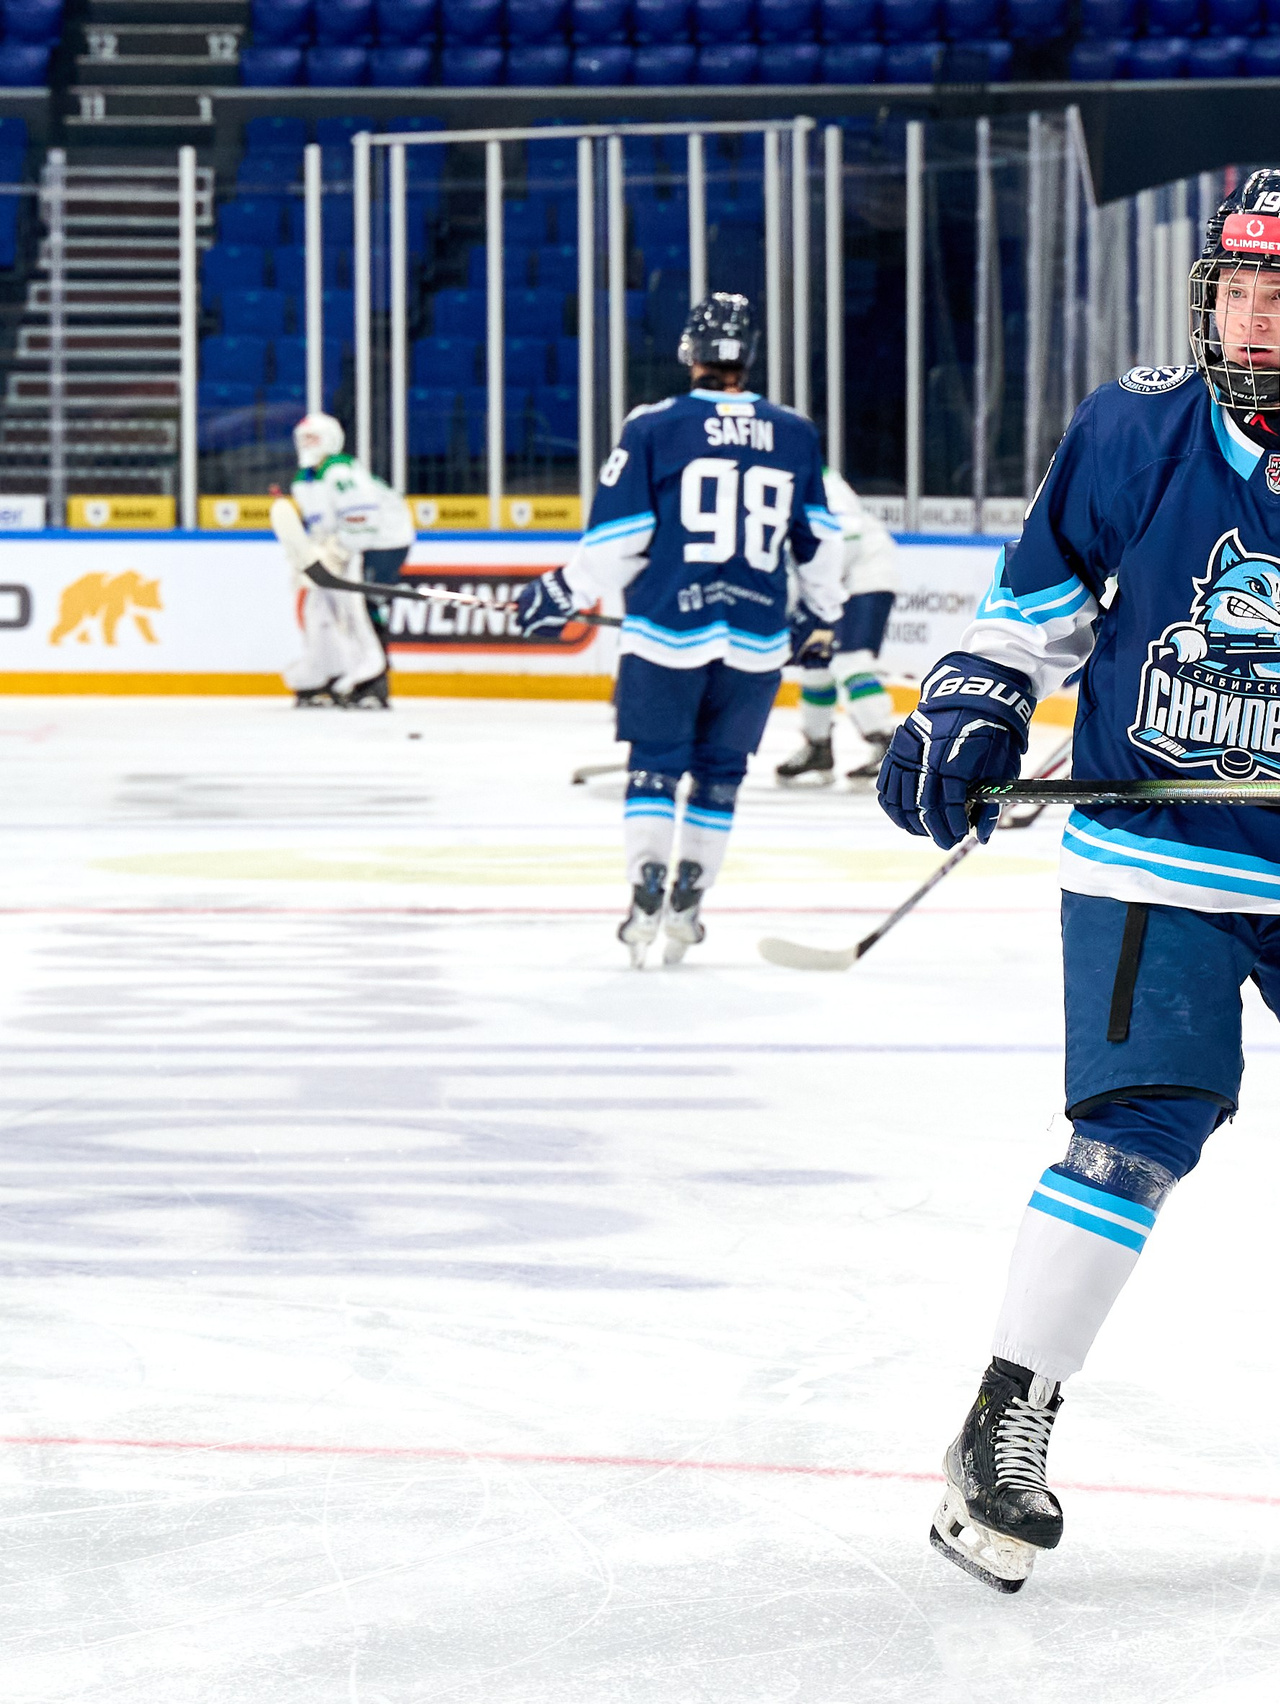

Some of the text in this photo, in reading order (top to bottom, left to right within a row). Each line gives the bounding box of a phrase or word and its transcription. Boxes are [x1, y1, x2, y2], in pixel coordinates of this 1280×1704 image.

[703, 416, 775, 452] SAFIN
[600, 448, 629, 487] 8
[680, 457, 795, 573] 98
[389, 583, 523, 635] NLIN
